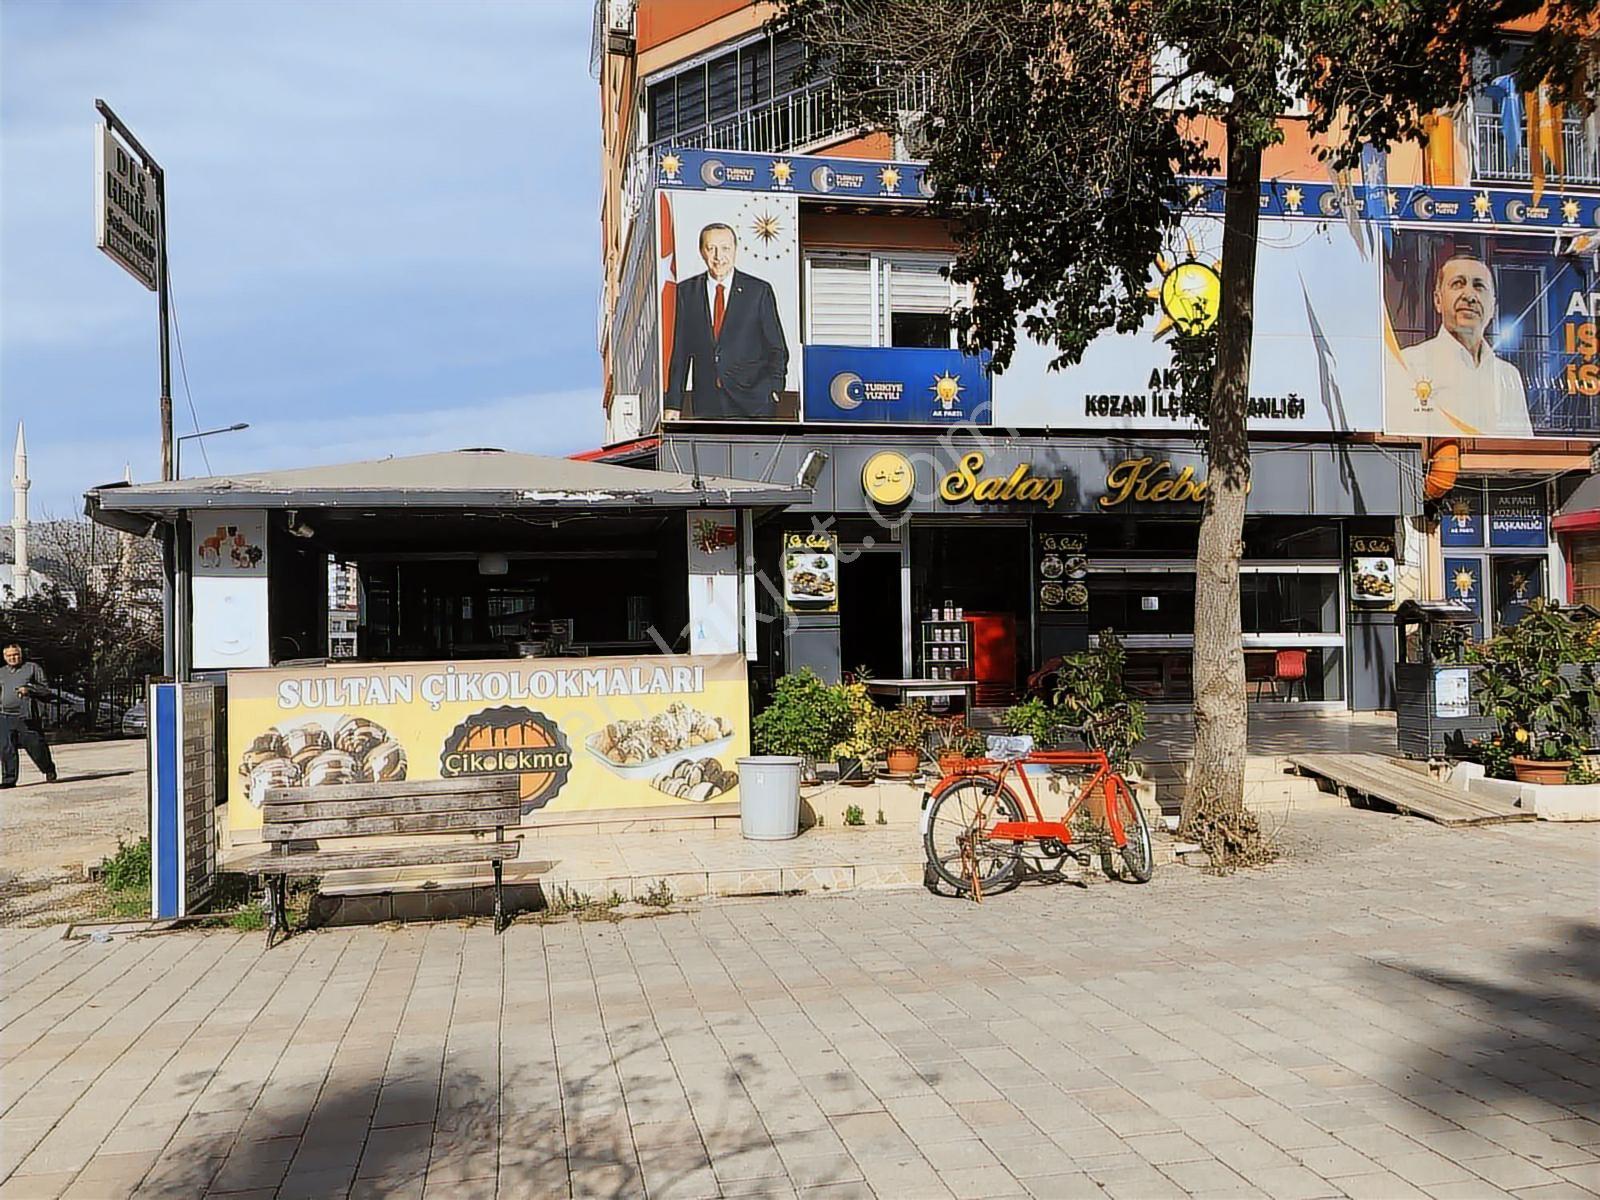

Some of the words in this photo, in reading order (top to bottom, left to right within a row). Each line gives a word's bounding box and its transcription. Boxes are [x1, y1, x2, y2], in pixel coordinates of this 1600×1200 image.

[1085, 395, 1146, 418] KOZAN
[940, 451, 1064, 509] Salaş
[277, 675, 414, 710] SULTAN
[420, 665, 706, 711] ÇİKOLOKMALARI
[445, 751, 568, 776] Çikolokma
